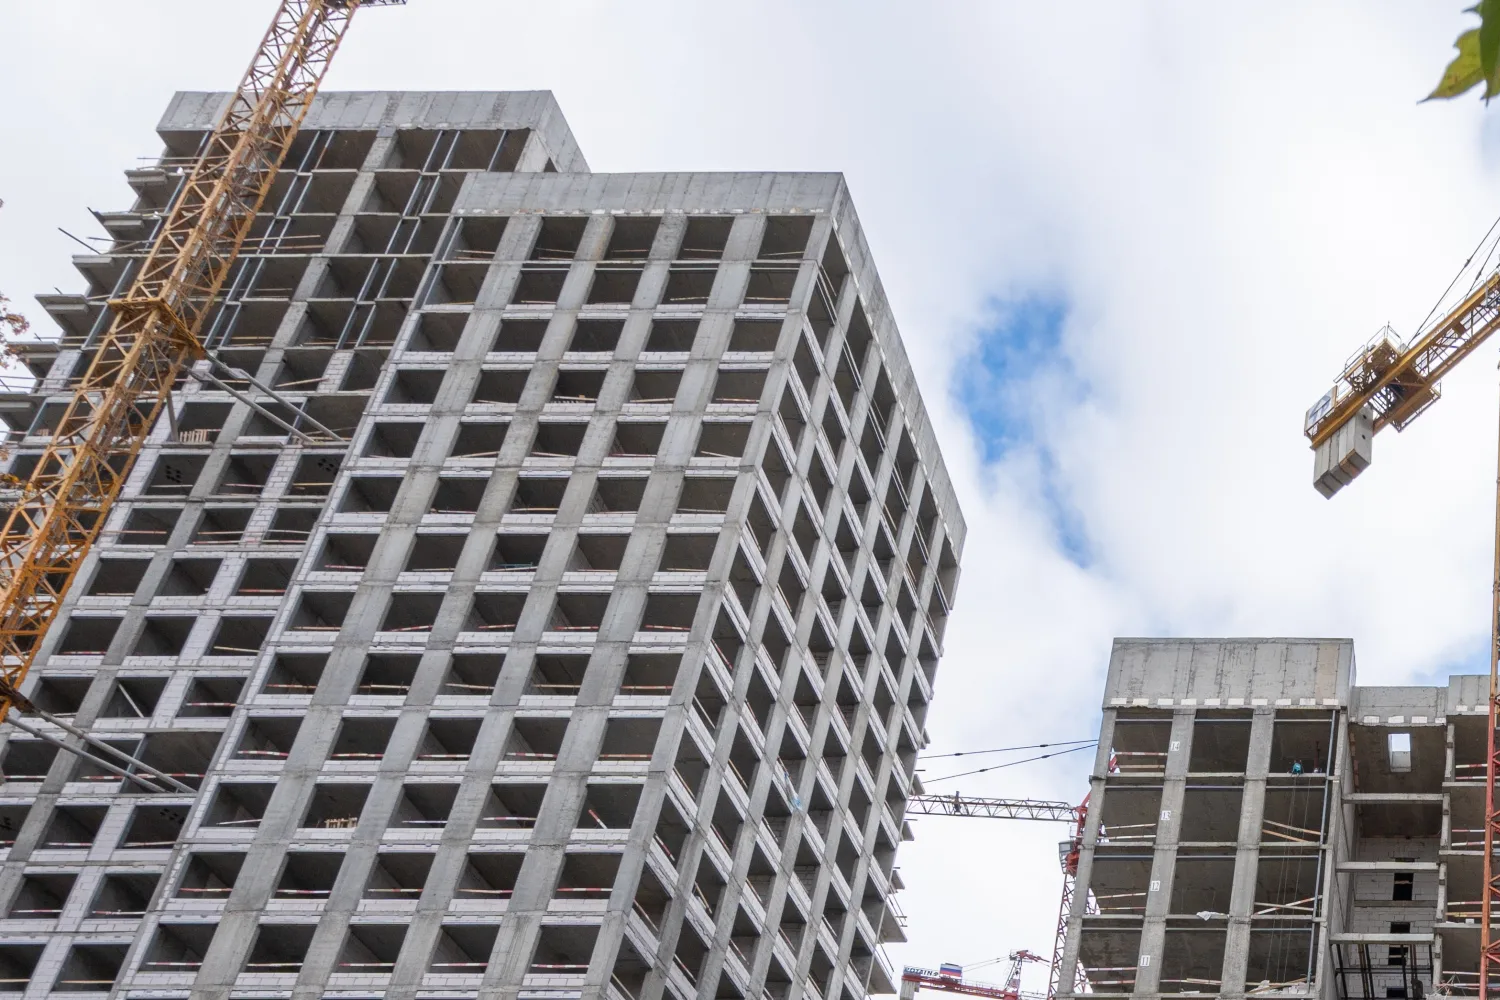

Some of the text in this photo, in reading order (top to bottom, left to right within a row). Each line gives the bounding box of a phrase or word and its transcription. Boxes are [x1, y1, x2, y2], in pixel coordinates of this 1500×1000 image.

[1171, 741, 1180, 750] 14
[1151, 881, 1160, 890] 12
[1141, 956, 1150, 966] 11
